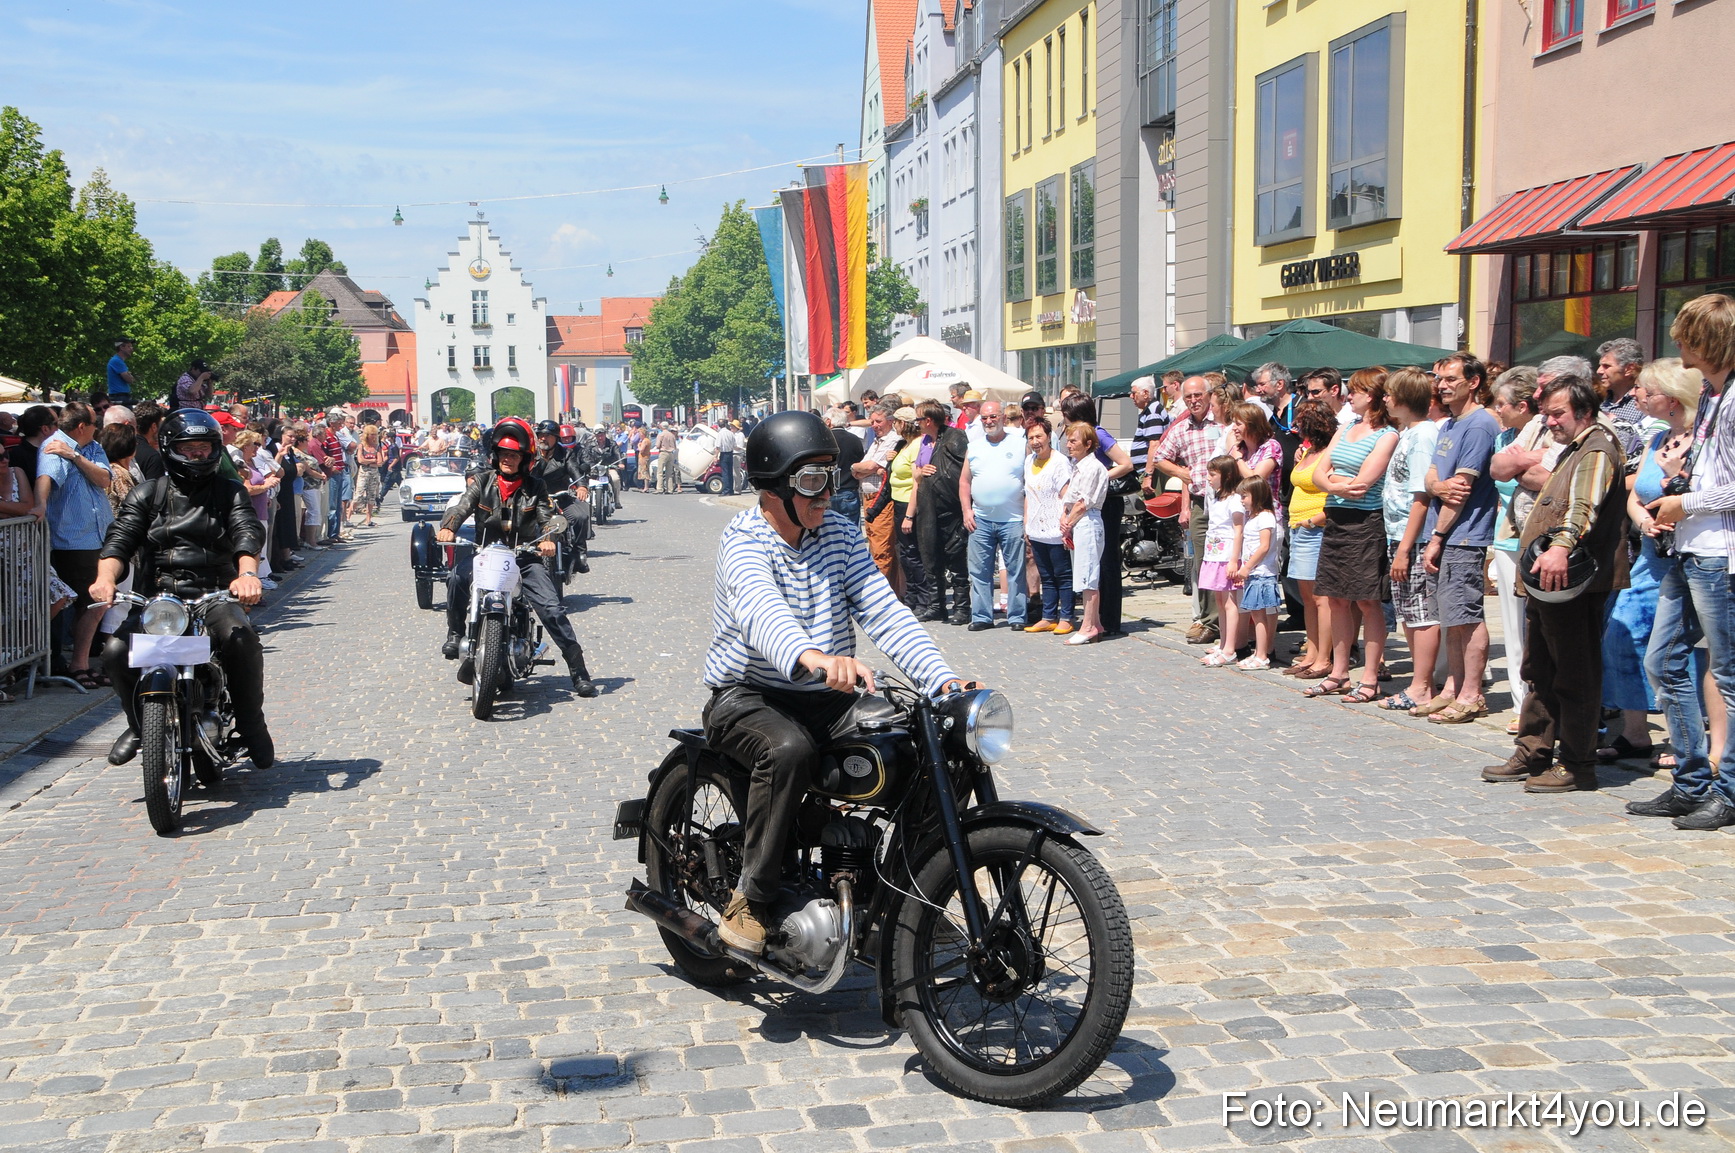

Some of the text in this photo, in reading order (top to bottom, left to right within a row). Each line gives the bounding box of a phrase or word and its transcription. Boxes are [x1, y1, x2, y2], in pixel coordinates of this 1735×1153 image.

[1281, 252, 1360, 288] GERRY WEBER
[922, 370, 956, 379] Segafredo
[503, 560, 510, 571] 3
